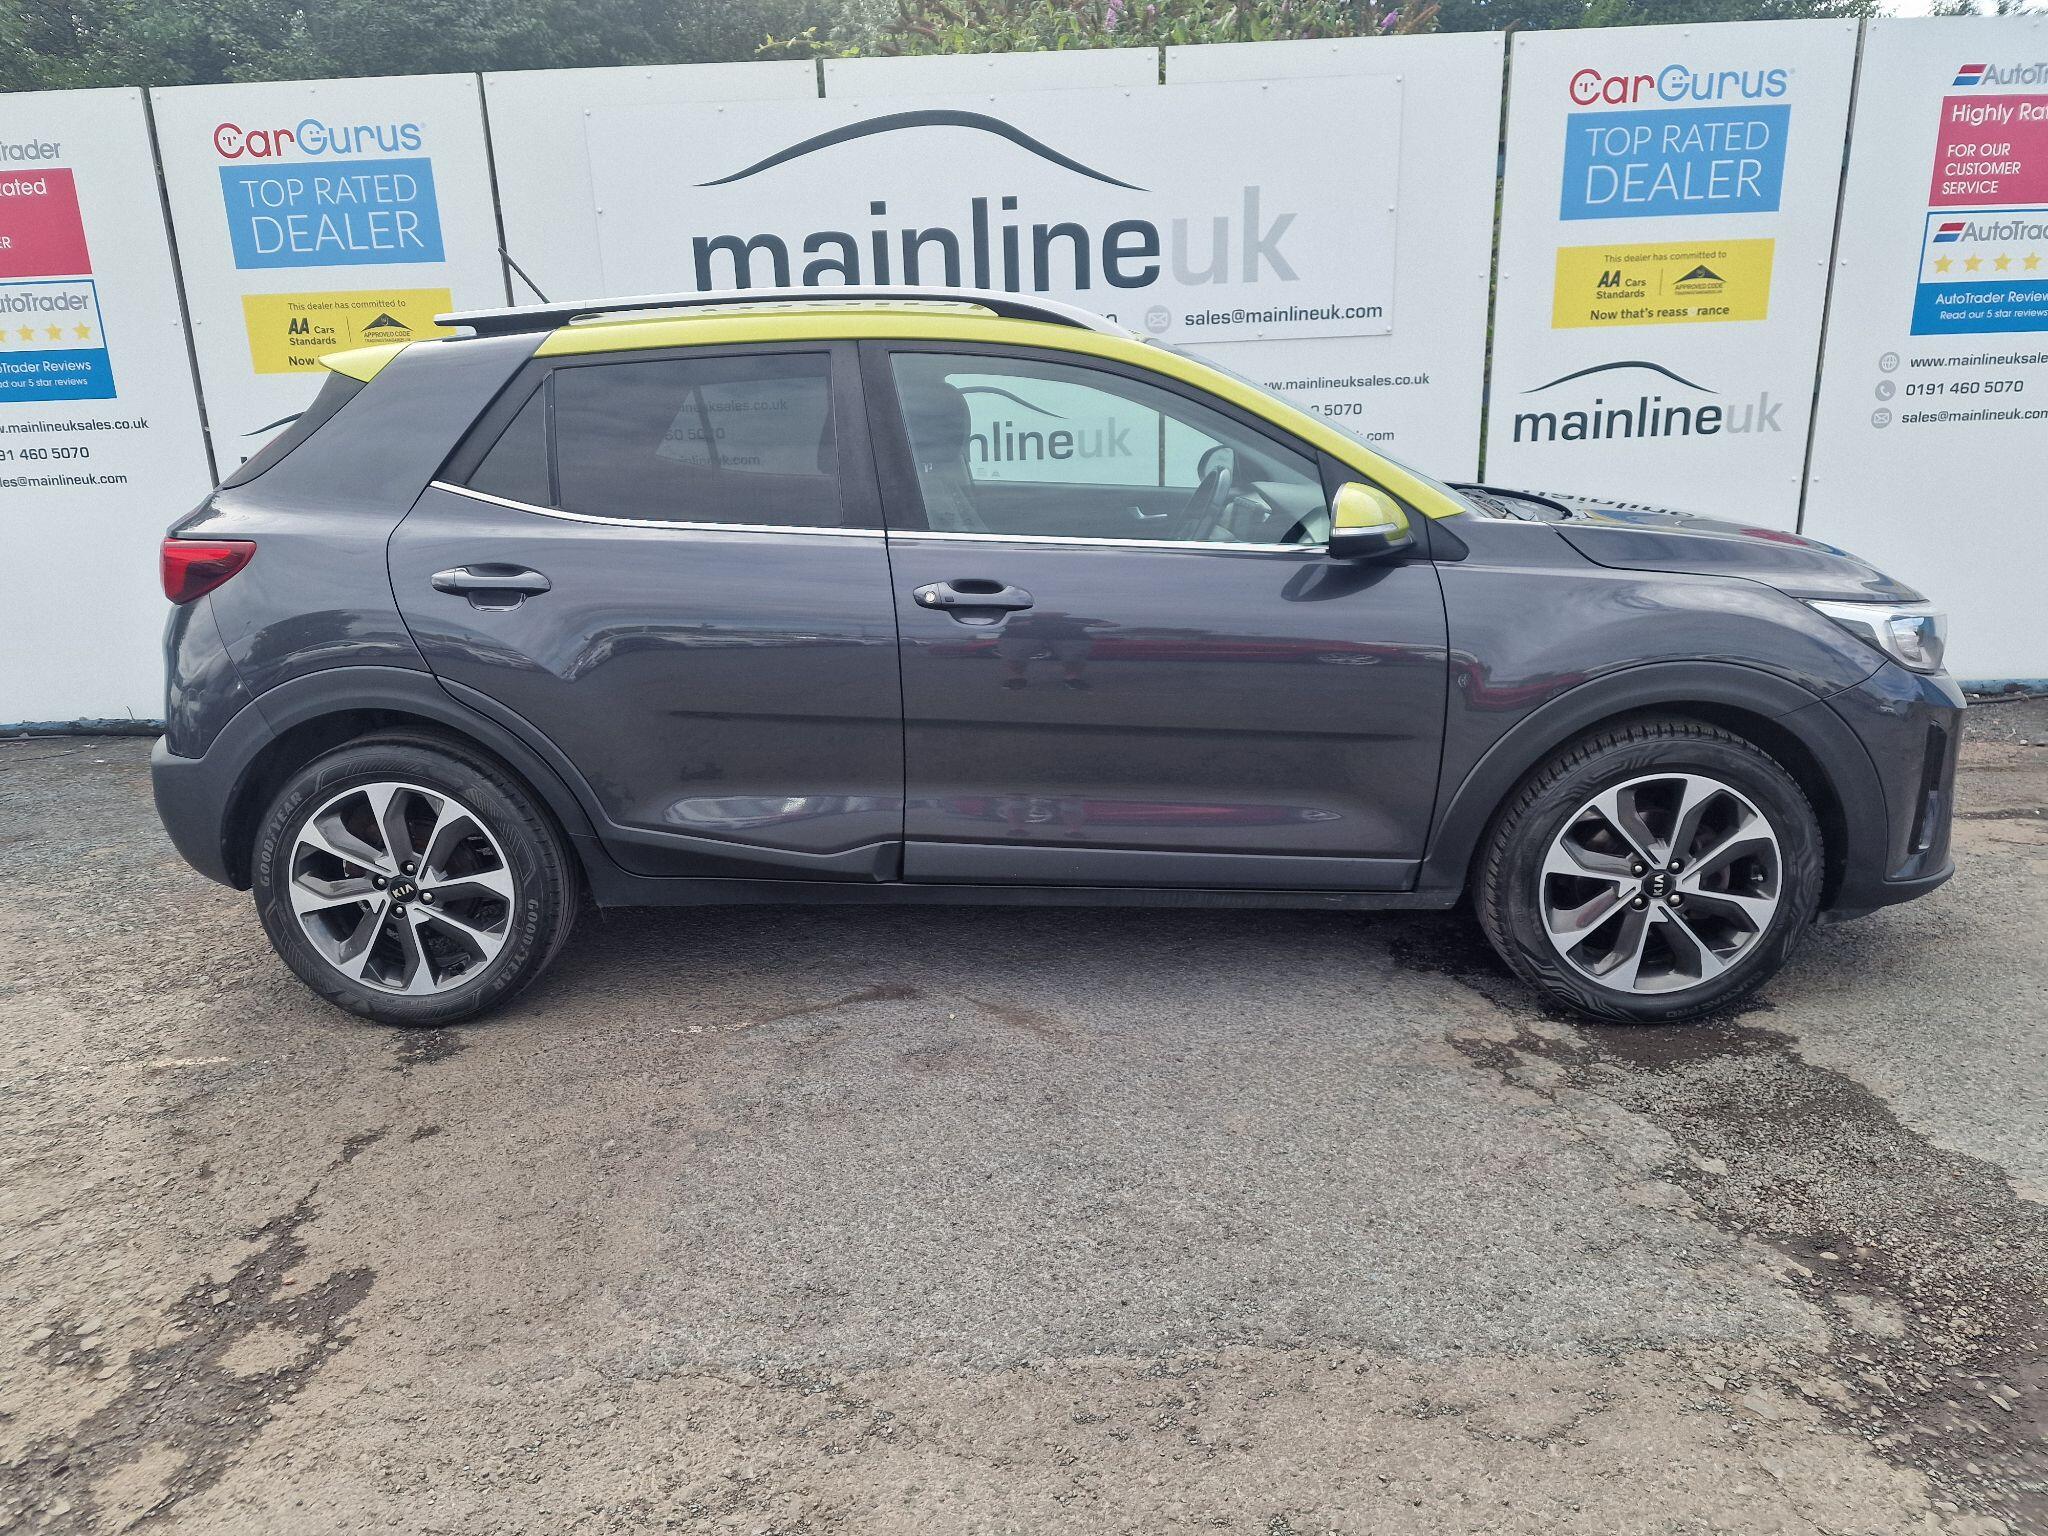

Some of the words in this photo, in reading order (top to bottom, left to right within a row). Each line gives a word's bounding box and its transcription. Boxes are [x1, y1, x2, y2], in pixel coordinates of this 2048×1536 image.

[1569, 64, 1788, 105] CarGurus
[1952, 103, 2014, 126] Highly
[213, 119, 422, 158] CarGurus
[1585, 126, 1652, 157] TOP
[1662, 121, 1770, 153] RATED
[0, 139, 60, 161] rader
[1947, 144, 1976, 157] FOR
[1980, 143, 2011, 156] OUR
[1945, 162, 2021, 176] CUSTOMER
[0, 178, 47, 197] ated
[1586, 159, 1762, 204] DEALER
[1942, 181, 1999, 195] SERVICE
[240, 179, 303, 208] TOP
[315, 175, 417, 205] RATED
[252, 211, 424, 253] DEALER
[692, 186, 1300, 293] mainlineuk
[1604, 255, 1622, 263] This
[1624, 254, 1651, 262] dealer
[1653, 253, 1668, 261] has
[1670, 251, 1716, 260] committed
[1718, 250, 1727, 259] to
[1597, 270, 1621, 288] AA
[1625, 278, 1646, 287] Cars
[1596, 290, 1645, 300] Standards
[1935, 293, 2004, 305] AutoTrader
[288, 303, 305, 311] This
[307, 302, 333, 311] dealer
[334, 301, 349, 309] has
[351, 300, 395, 309] committed
[397, 299, 406, 307] to
[1590, 309, 1617, 320] Now
[1621, 307, 1653, 319] that's
[1657, 306, 1730, 318] reassrance
[1185, 304, 1383, 326] sales@mainlineuk.com
[1940, 310, 1966, 320] Read
[1969, 311, 1984, 319] our
[1987, 309, 1993, 318] 5
[1994, 310, 2012, 318] star
[288, 317, 310, 335] AA
[314, 326, 335, 334] Cars
[289, 336, 336, 346] Standards
[0, 361, 40, 373] Trader
[42, 360, 92, 372] Reviews
[288, 356, 314, 366] Now
[11, 380, 26, 388] our
[28, 378, 34, 387] 5
[36, 378, 52, 386] star
[55, 377, 88, 386] reviews
[1906, 383, 1944, 396] 0191
[1949, 381, 1980, 394] 460
[1984, 380, 2024, 394] 5070
[1324, 403, 1362, 416] 5070
[1513, 391, 1784, 442] mainlineuk
[969, 417, 1132, 461] nlineuk
[20, 448, 48, 460] 460
[51, 447, 90, 459] 5070
[392, 884, 414, 898] KIA
[1653, 875, 1664, 896] KIA
